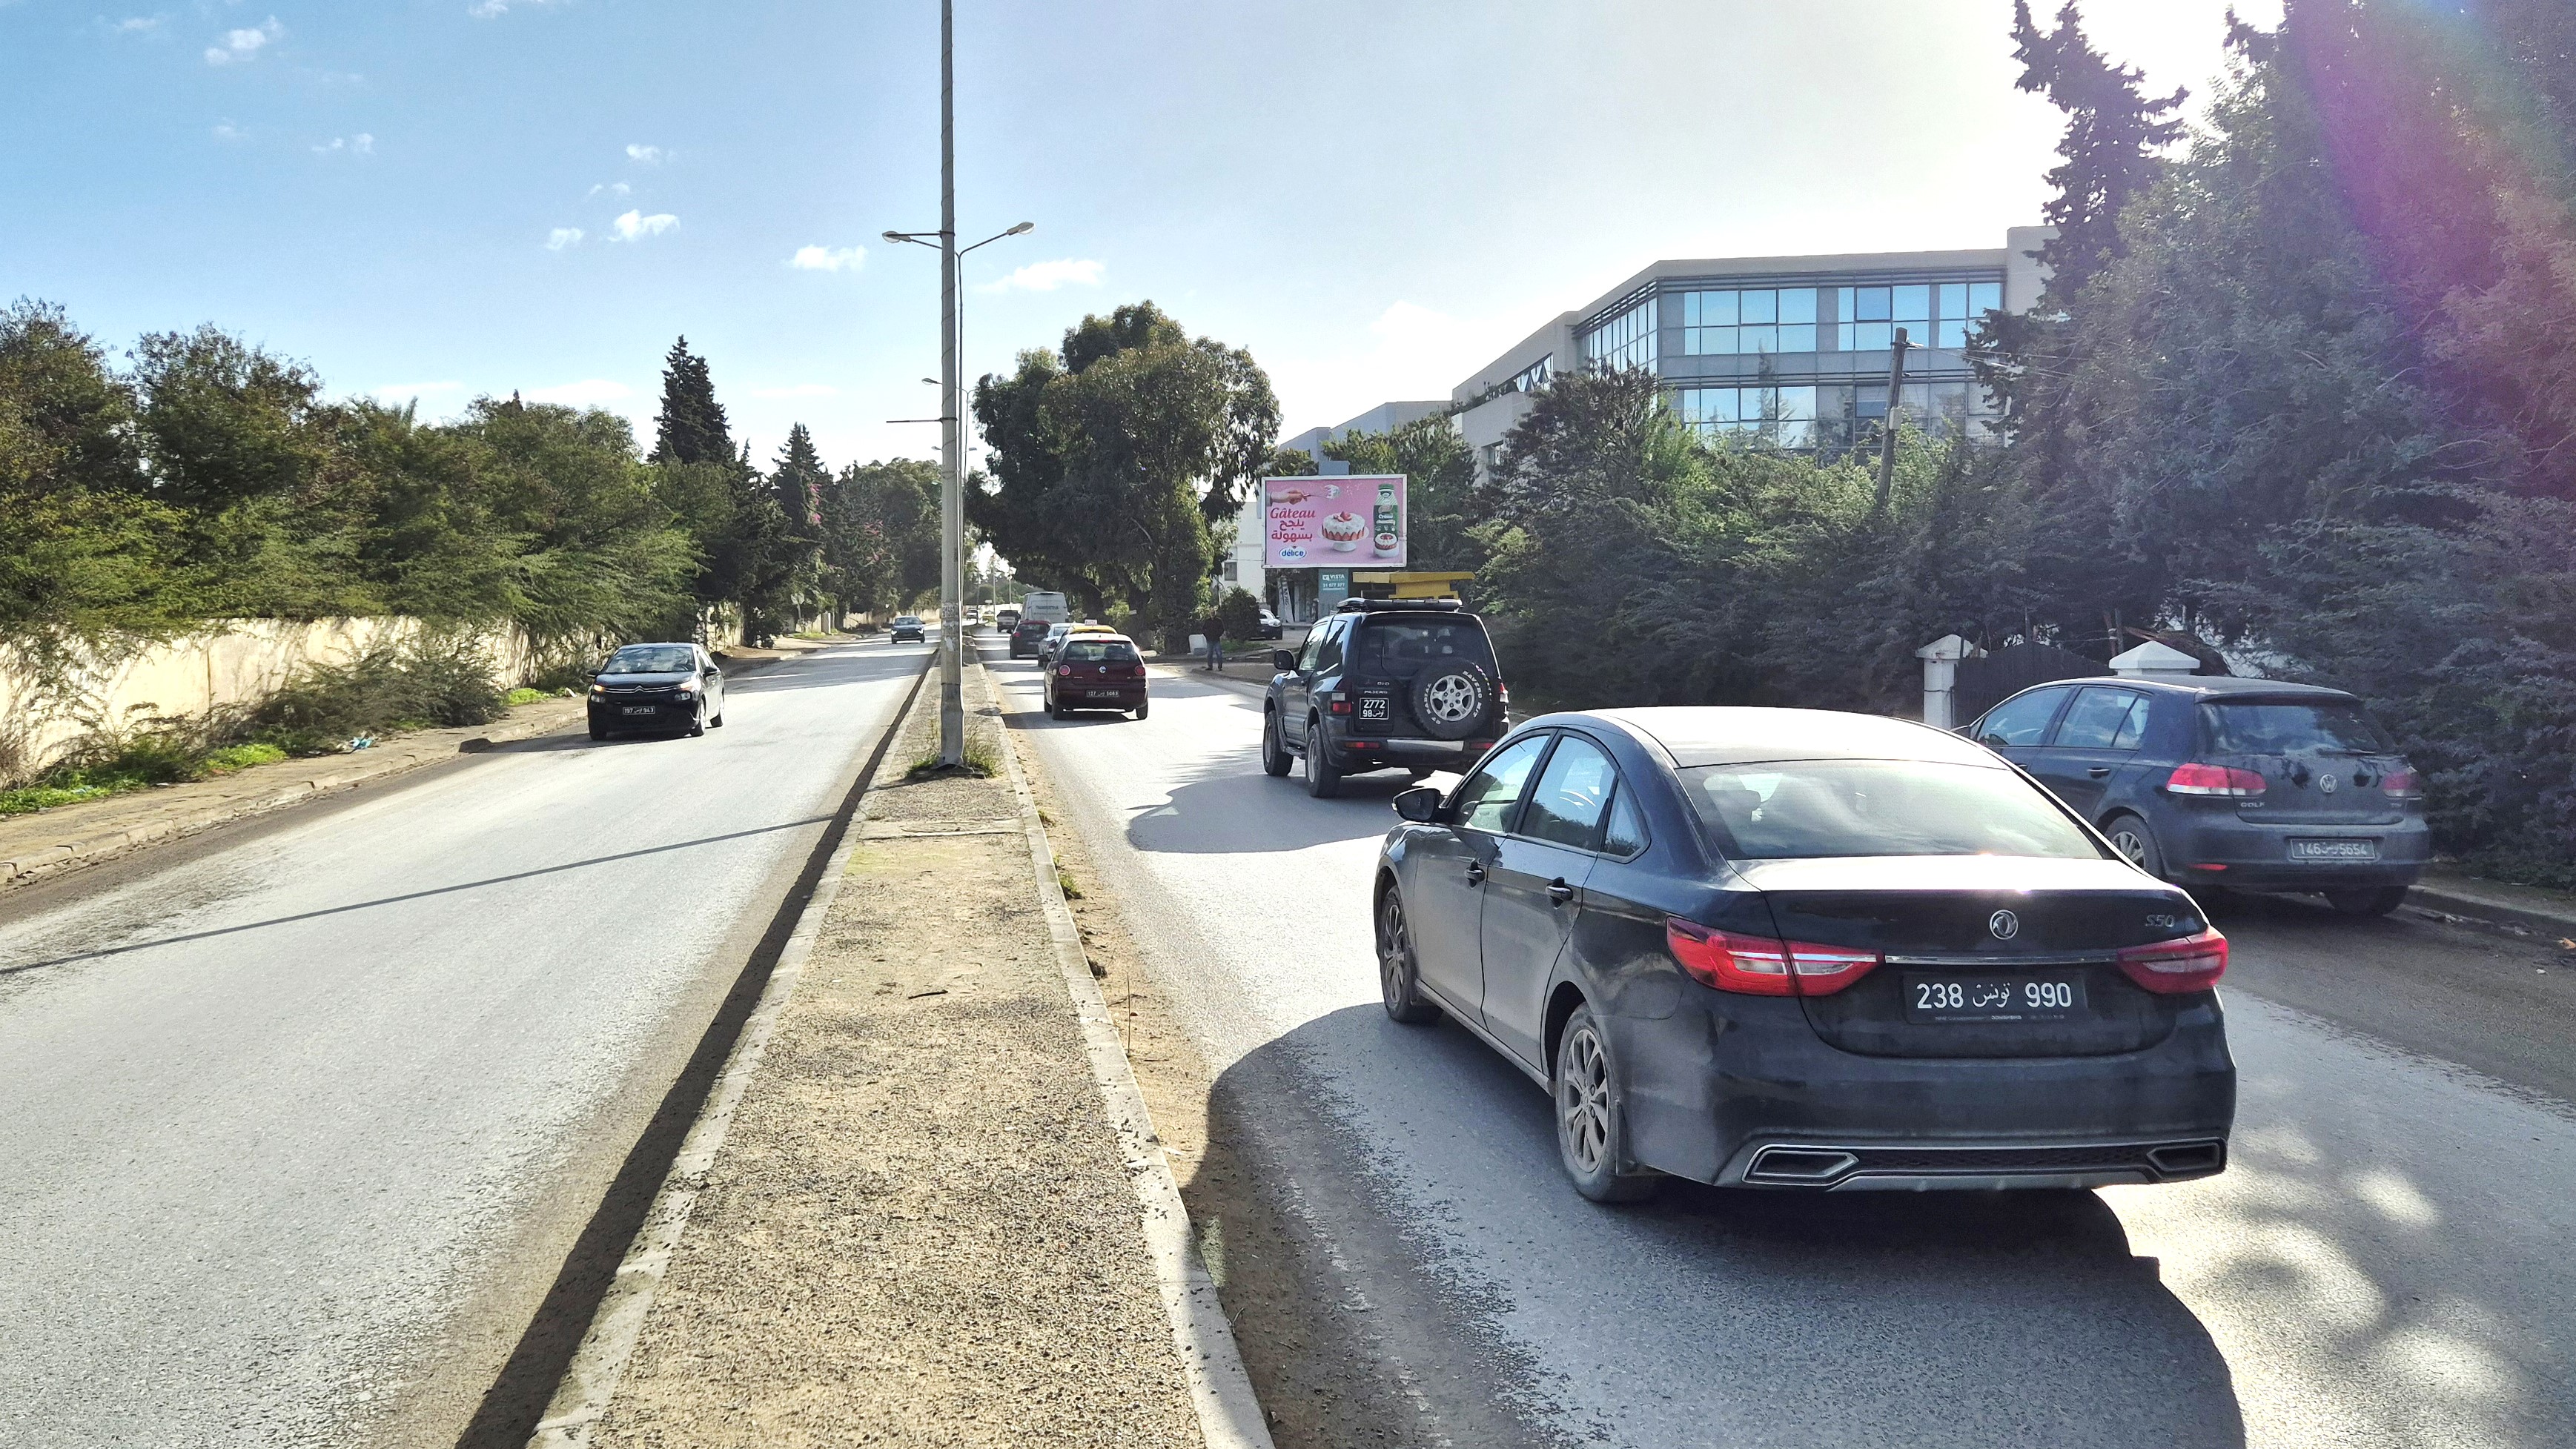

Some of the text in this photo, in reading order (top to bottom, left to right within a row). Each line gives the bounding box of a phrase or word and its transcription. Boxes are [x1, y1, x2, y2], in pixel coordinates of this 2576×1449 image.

[1270, 508, 1316, 519] Gâteau
[1271, 530, 1313, 543] بسهولة
[1363, 699, 1385, 709] 2772
[1363, 709, 1372, 717] 98
[2145, 915, 2176, 927] S50
[1916, 982, 2072, 1009] 238 تونس 990
